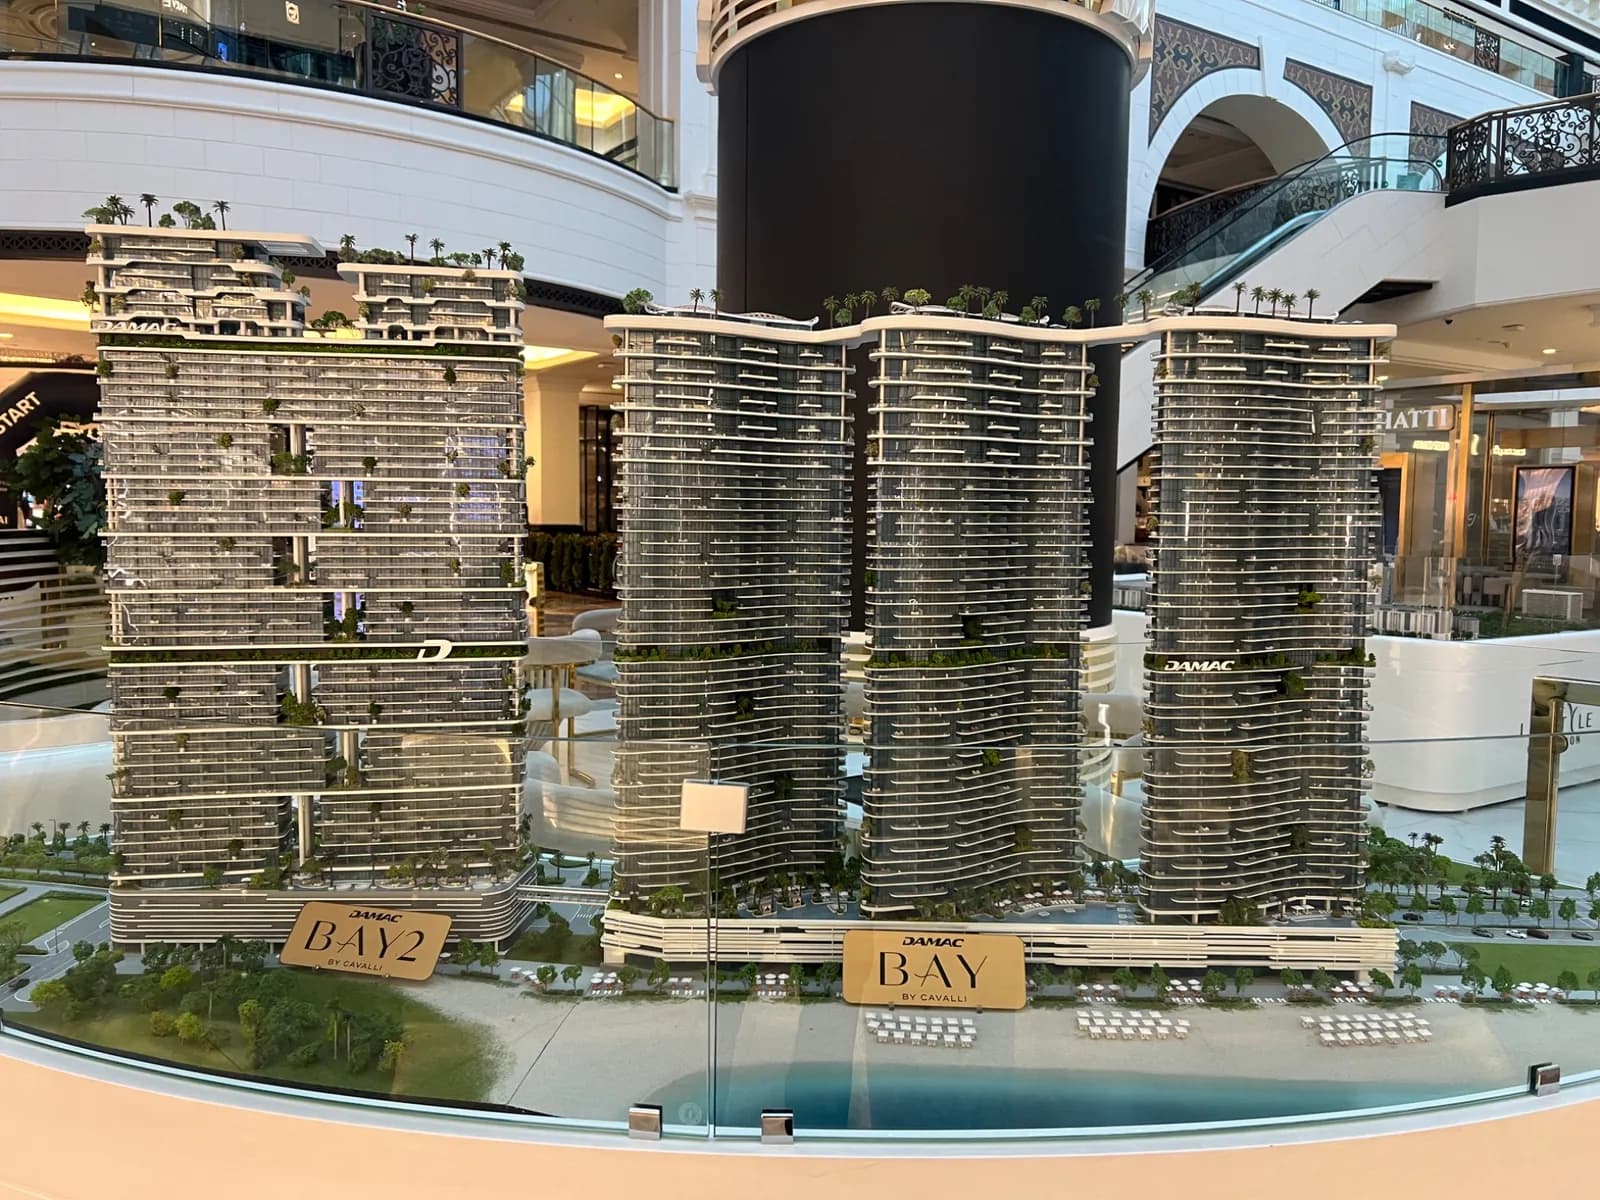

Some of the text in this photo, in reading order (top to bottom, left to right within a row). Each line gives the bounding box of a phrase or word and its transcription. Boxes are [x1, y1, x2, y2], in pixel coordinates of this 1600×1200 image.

[98, 321, 177, 332] DAMAC
[1164, 660, 1235, 671] DAMAC
[349, 910, 403, 923] DAMAC
[902, 936, 965, 948] DAMAC
[328, 958, 383, 971] BY CAVALLI
[879, 951, 988, 989] BAY
[902, 993, 967, 1003] BY CAVALLI
